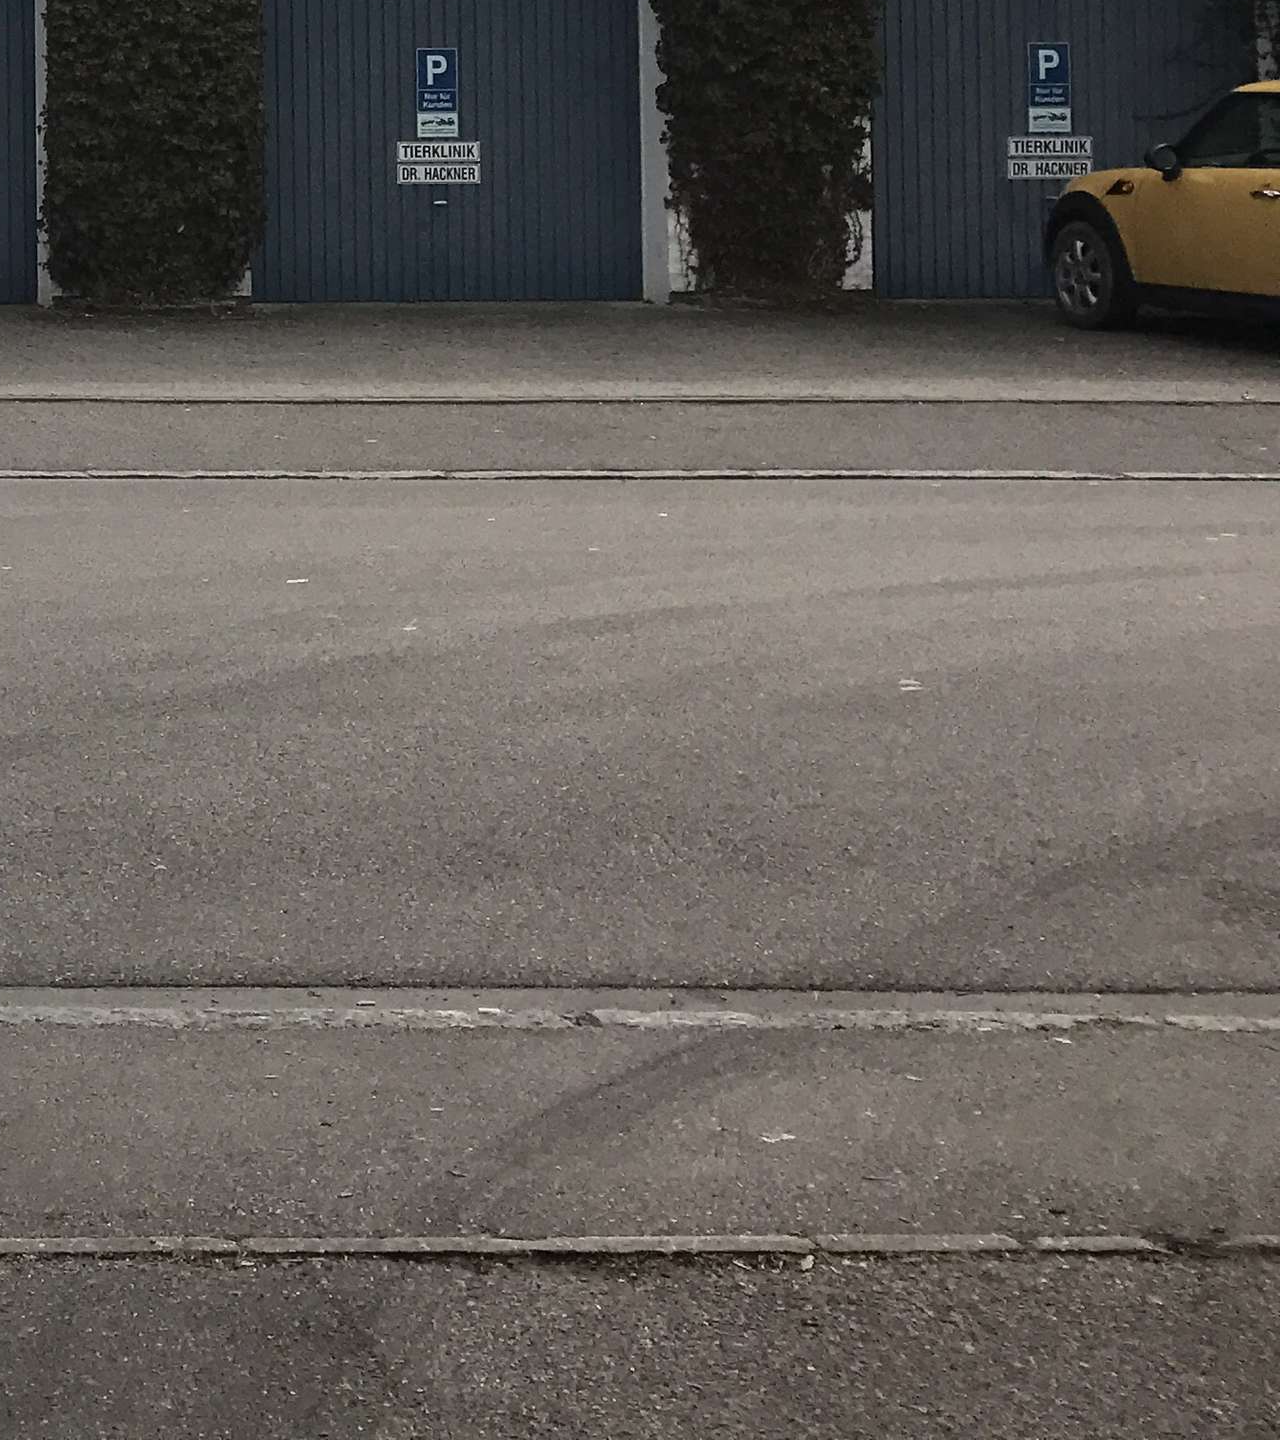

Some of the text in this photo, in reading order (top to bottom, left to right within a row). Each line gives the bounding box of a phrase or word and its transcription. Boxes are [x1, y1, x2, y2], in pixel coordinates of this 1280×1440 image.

[426, 55, 448, 86] P
[1038, 49, 1060, 80] P
[423, 100, 453, 109] Kunden
[402, 145, 475, 159] TIERKLINIK
[1013, 140, 1088, 154] TIERKLINIK
[402, 167, 475, 181] DR. HACKNER
[1013, 161, 1088, 176] DR. HACKNER
